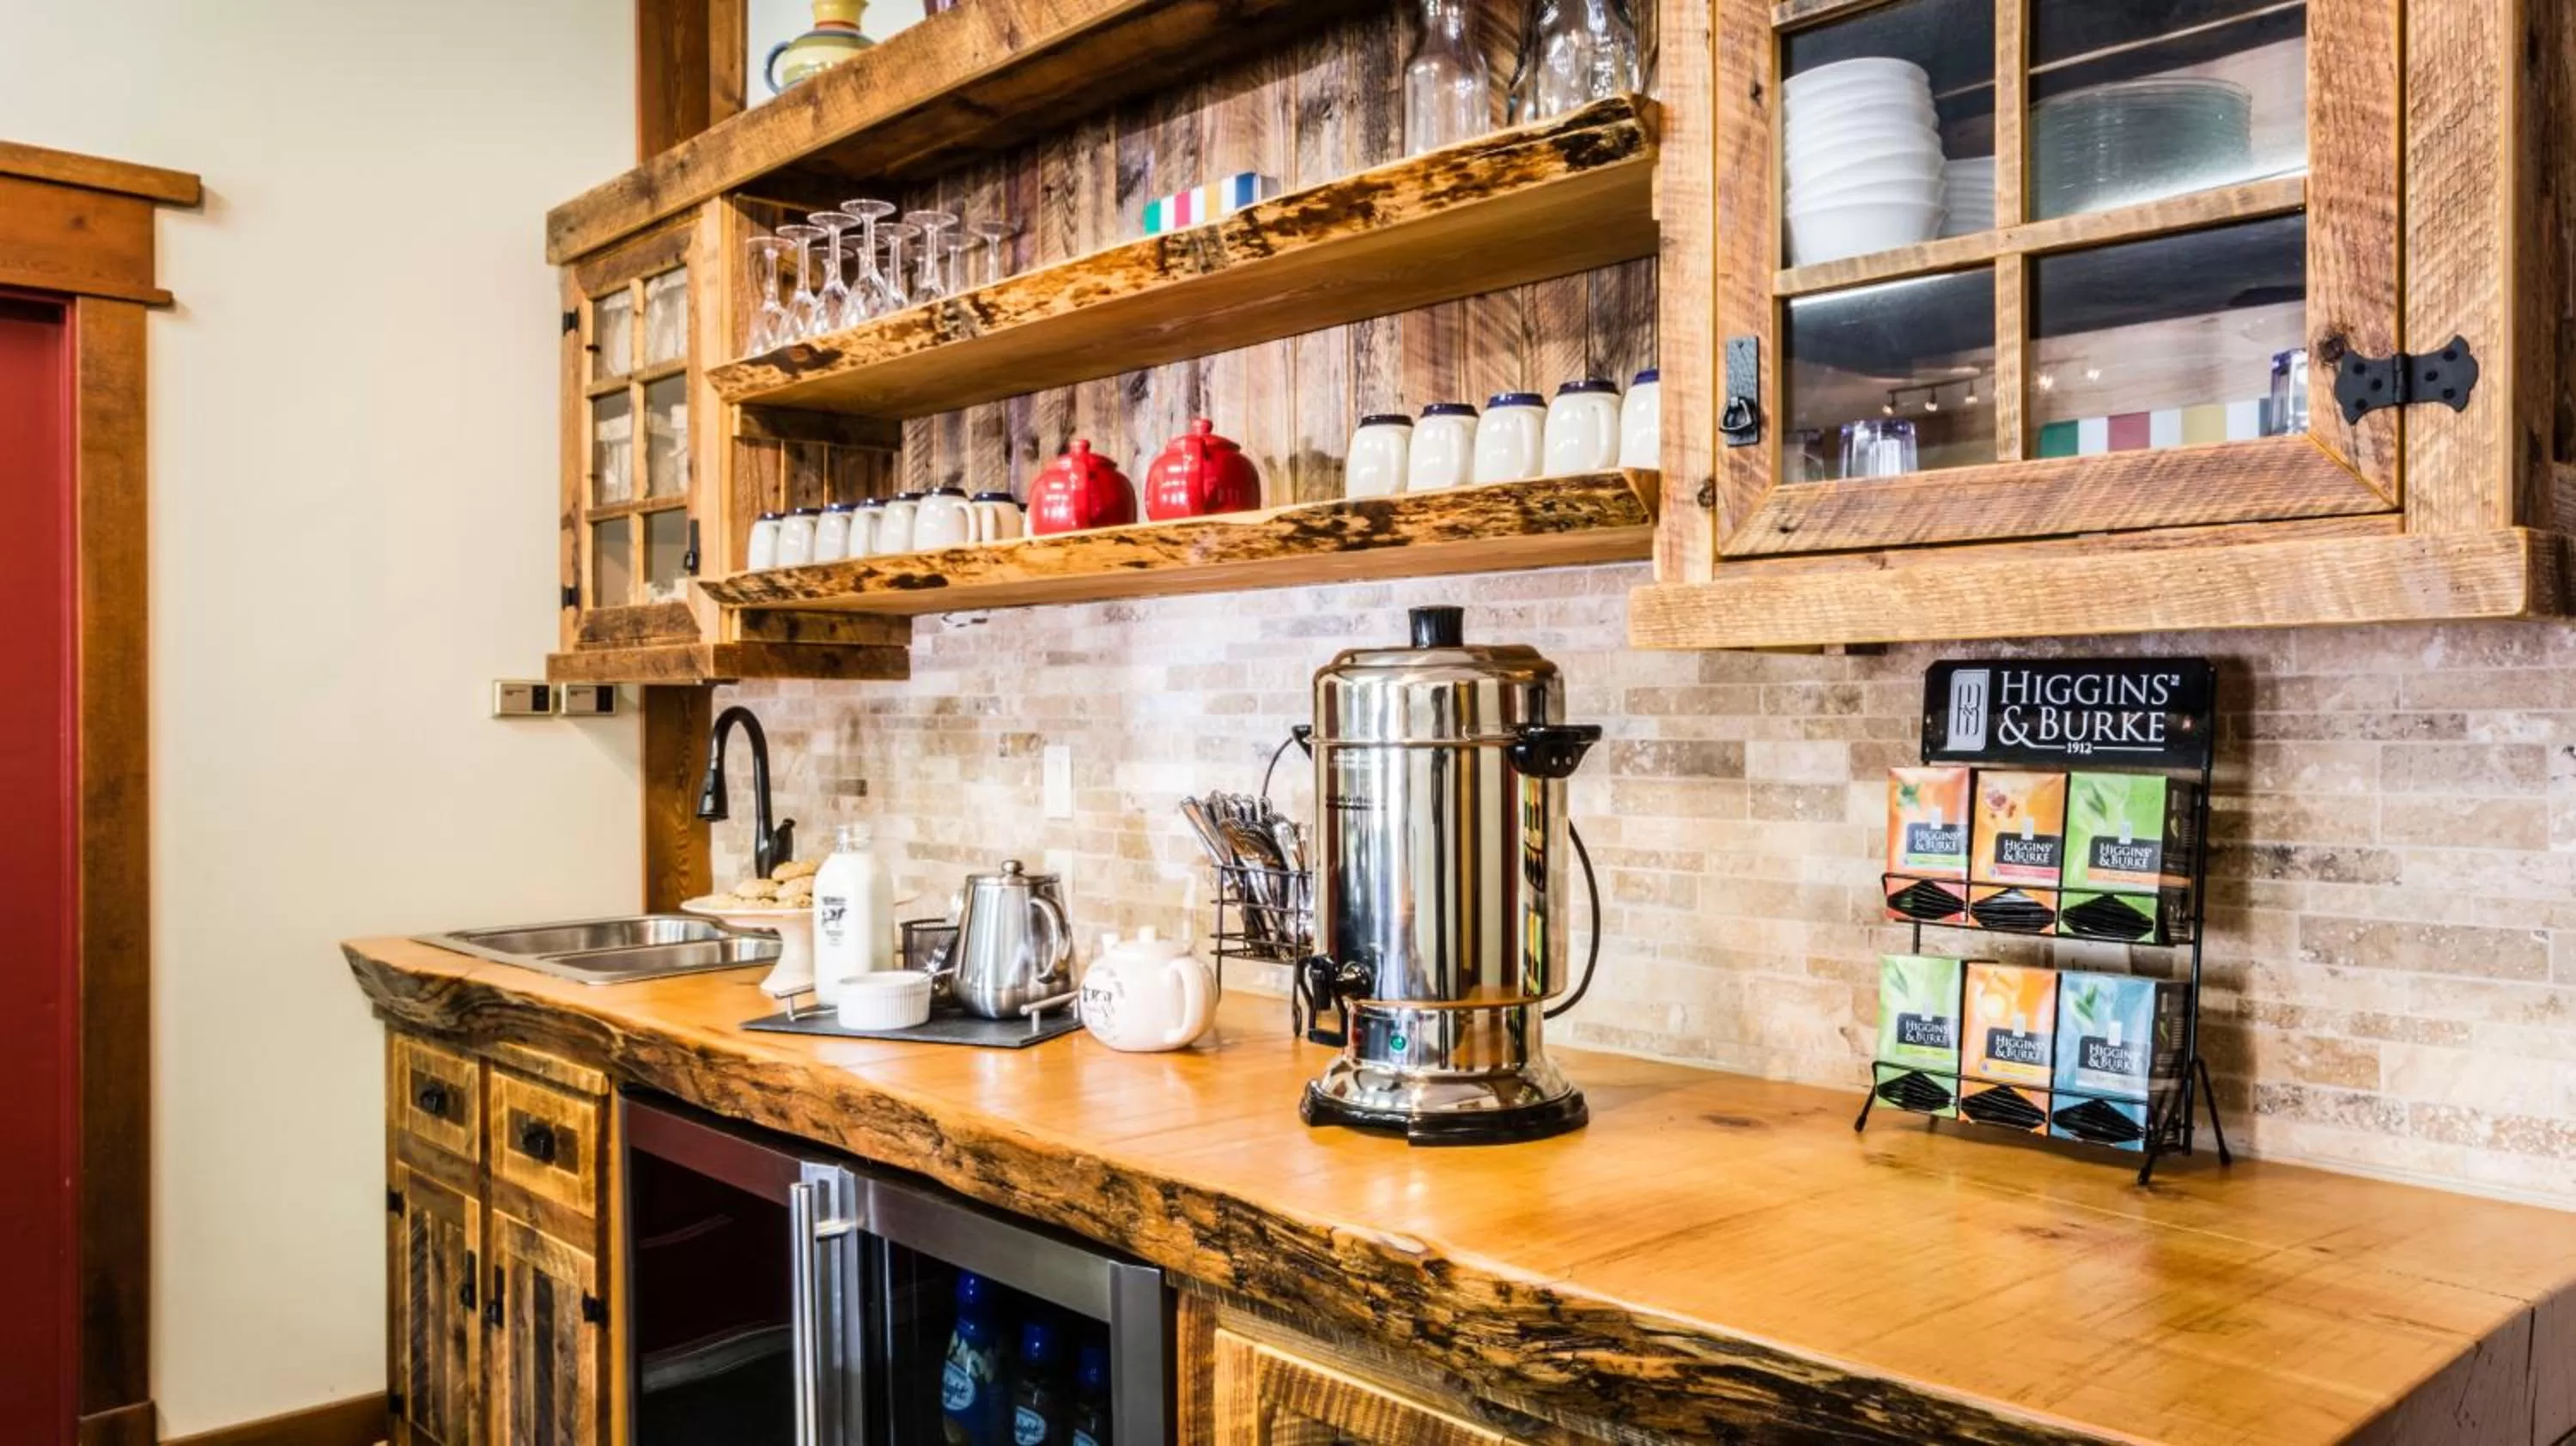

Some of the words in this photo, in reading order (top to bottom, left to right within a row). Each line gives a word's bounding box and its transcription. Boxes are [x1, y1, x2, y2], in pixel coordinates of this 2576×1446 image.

[2000, 670, 2169, 706] HIGGINS
[2065, 742, 2093, 754] 1912
[2003, 839, 2051, 853] HIGGINS
[2099, 842, 2150, 858] HIGGINS
